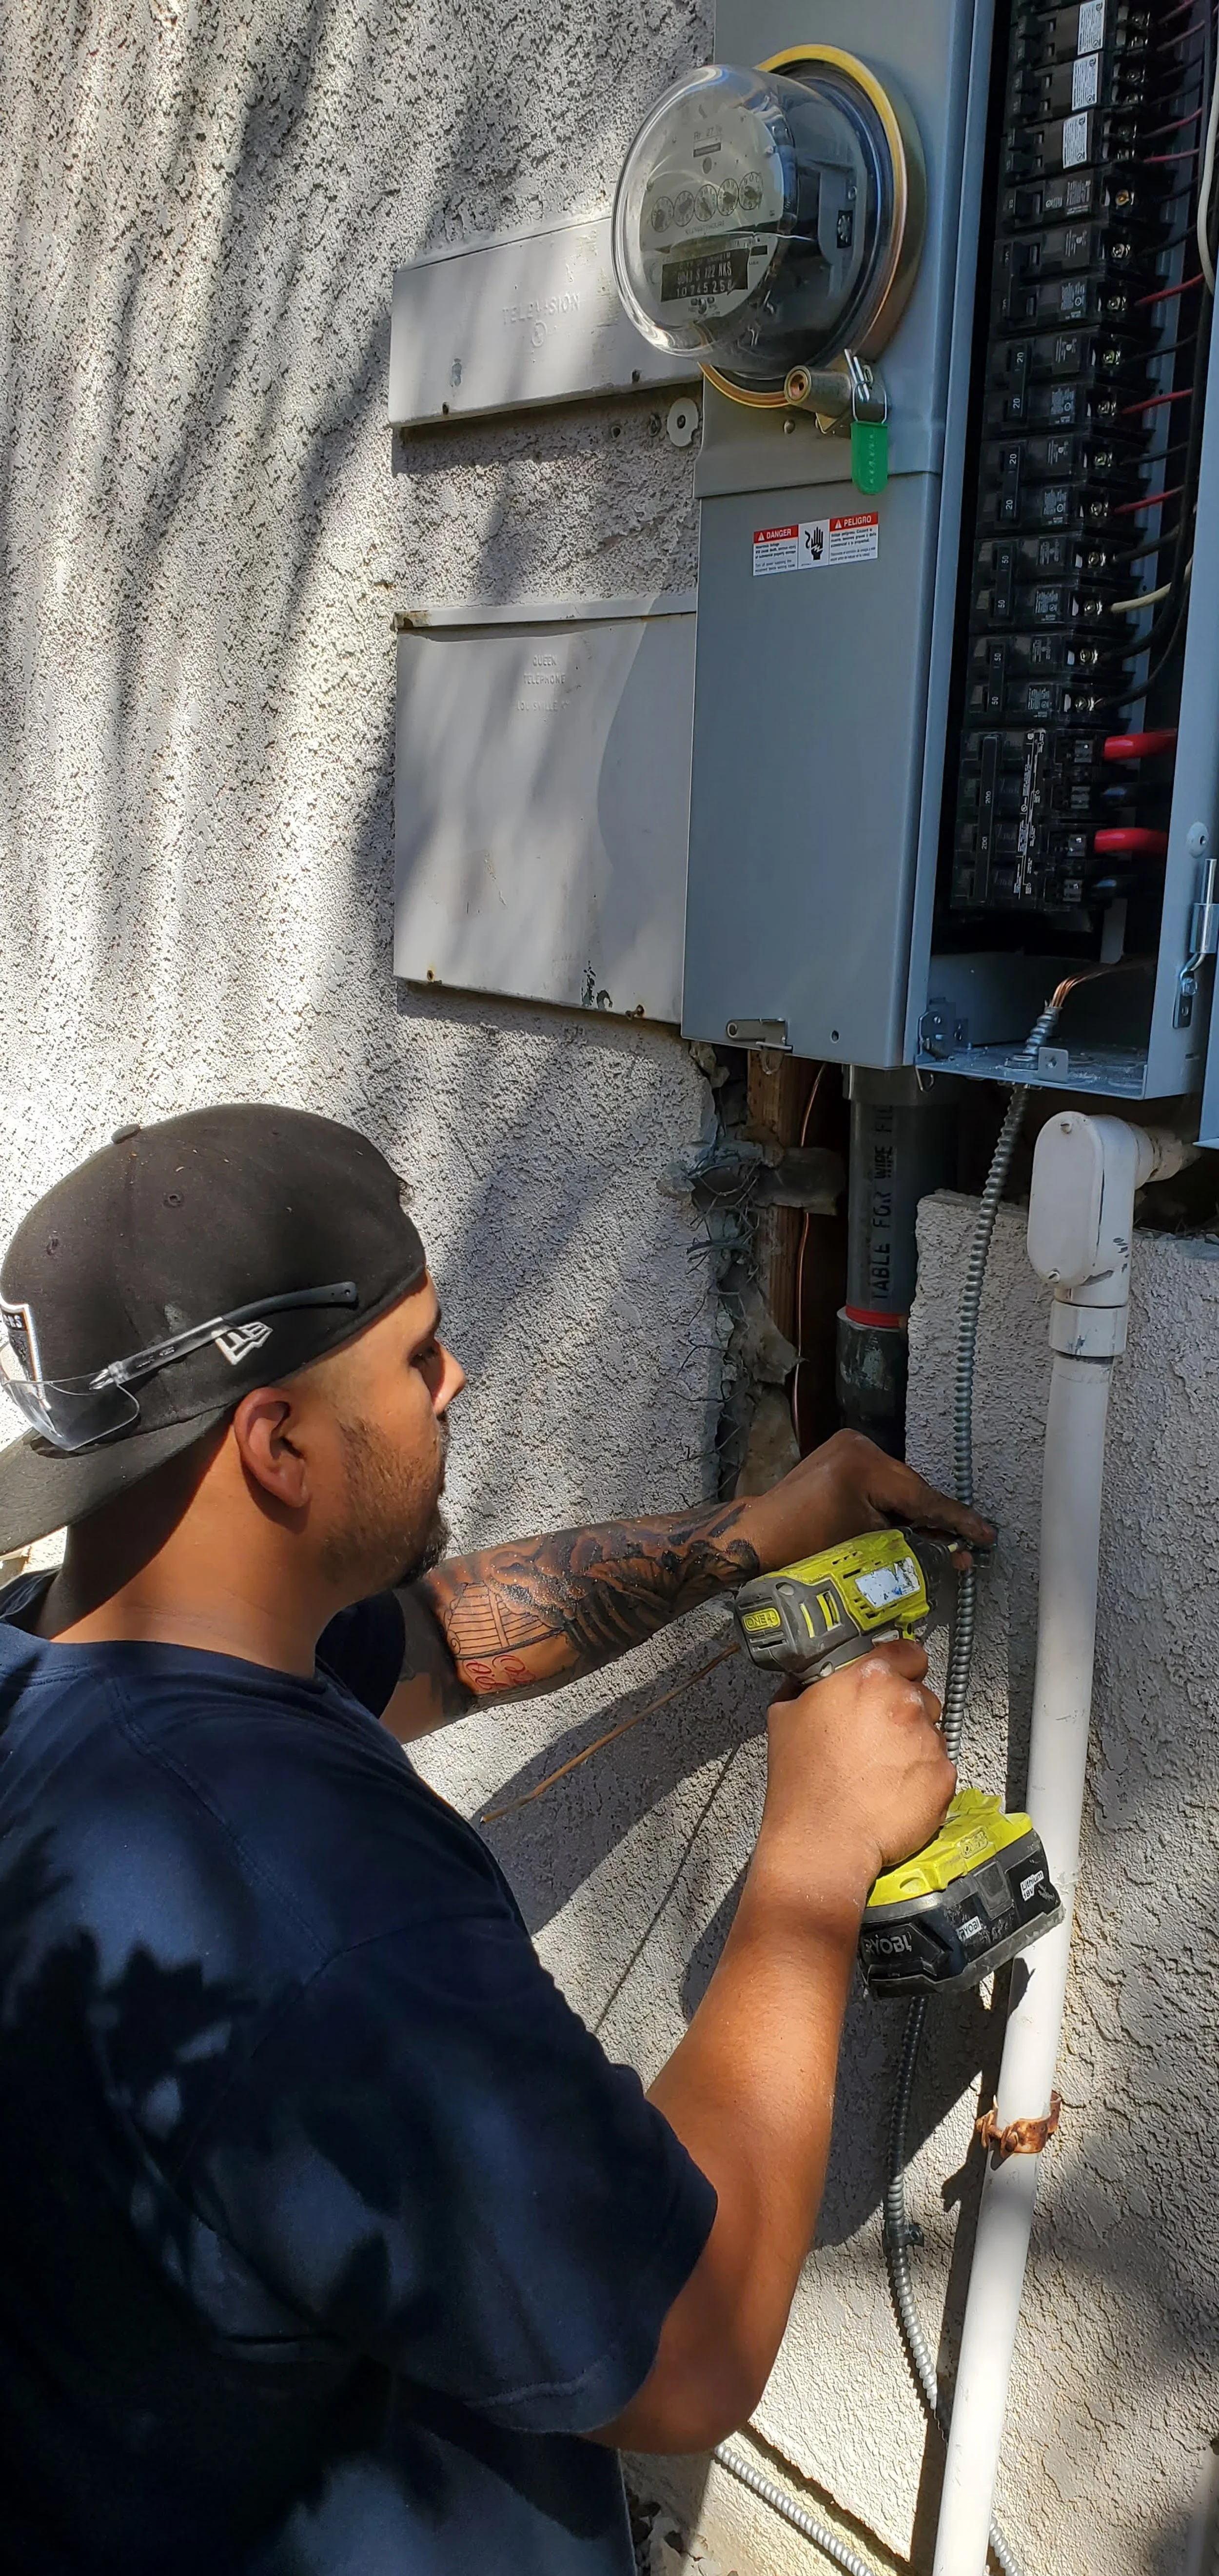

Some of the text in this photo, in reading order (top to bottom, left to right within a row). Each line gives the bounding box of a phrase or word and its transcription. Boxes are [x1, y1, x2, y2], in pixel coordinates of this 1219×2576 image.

[502, 291, 581, 326] TELEVISION
[1017, 352, 1024, 363] 20
[1013, 398, 1020, 409] 20
[1009, 454, 1017, 464] 20
[1006, 500, 1013, 510] 20
[844, 515, 872, 527] PELIGRO
[767, 529, 791, 539] DANGER
[1002, 555, 1009, 564] 50
[998, 600, 1005, 608] 50
[532, 654, 556, 666] QUEEN
[994, 653, 1001, 661] 50
[524, 673, 566, 684] TELEPHONE
[992, 697, 999, 705] 50
[874, 1145, 893, 1179] WIRE
[873, 1192, 891, 1228] FOR
[1022, 1872, 1042, 1890] Lithium
[1023, 1888, 1034, 1899] 18V
[959, 1919, 980, 1939] RYOBI
[865, 1932, 912, 1954] RYOBI
